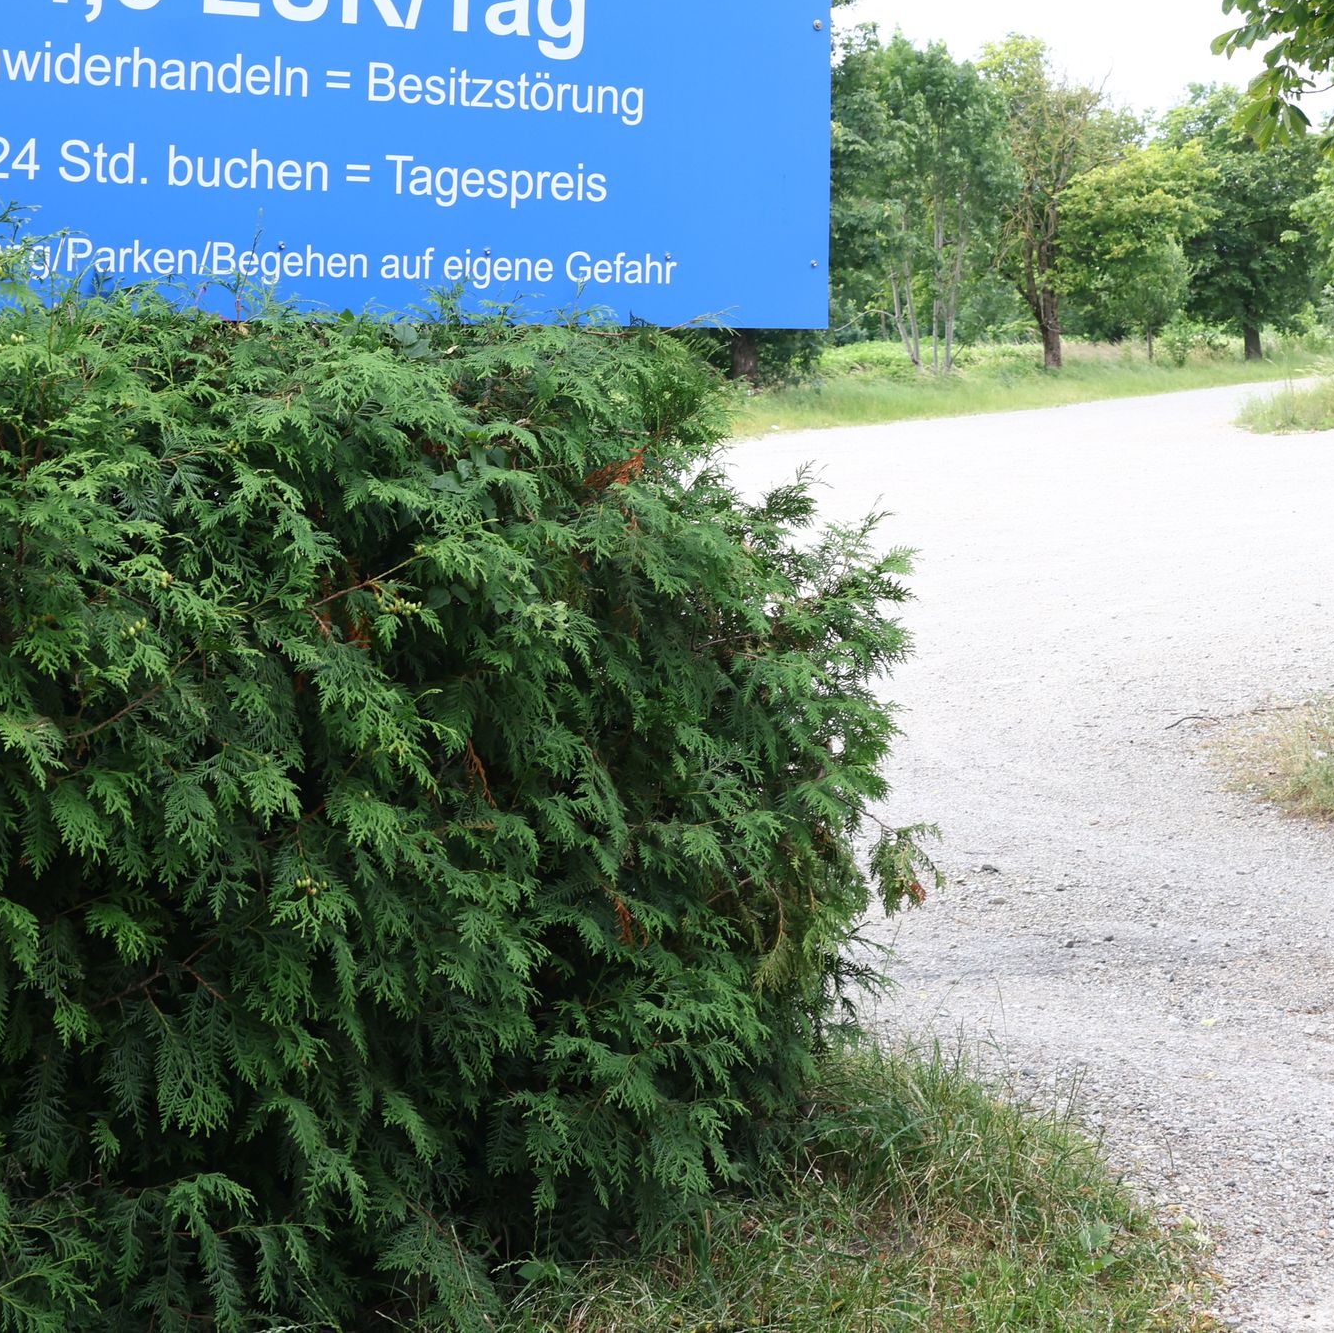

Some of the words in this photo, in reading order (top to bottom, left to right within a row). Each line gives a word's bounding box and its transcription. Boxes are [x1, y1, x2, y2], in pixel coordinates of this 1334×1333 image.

[326, 70, 351, 89] =
[368, 61, 644, 126] Besitzstörung
[58, 139, 148, 184] Std.
[168, 144, 328, 192] buchen
[346, 164, 371, 182] =
[385, 154, 607, 209] Tagespreis
[380, 247, 435, 280] auf
[443, 249, 554, 289] eigene
[565, 251, 678, 284] Gefahr
